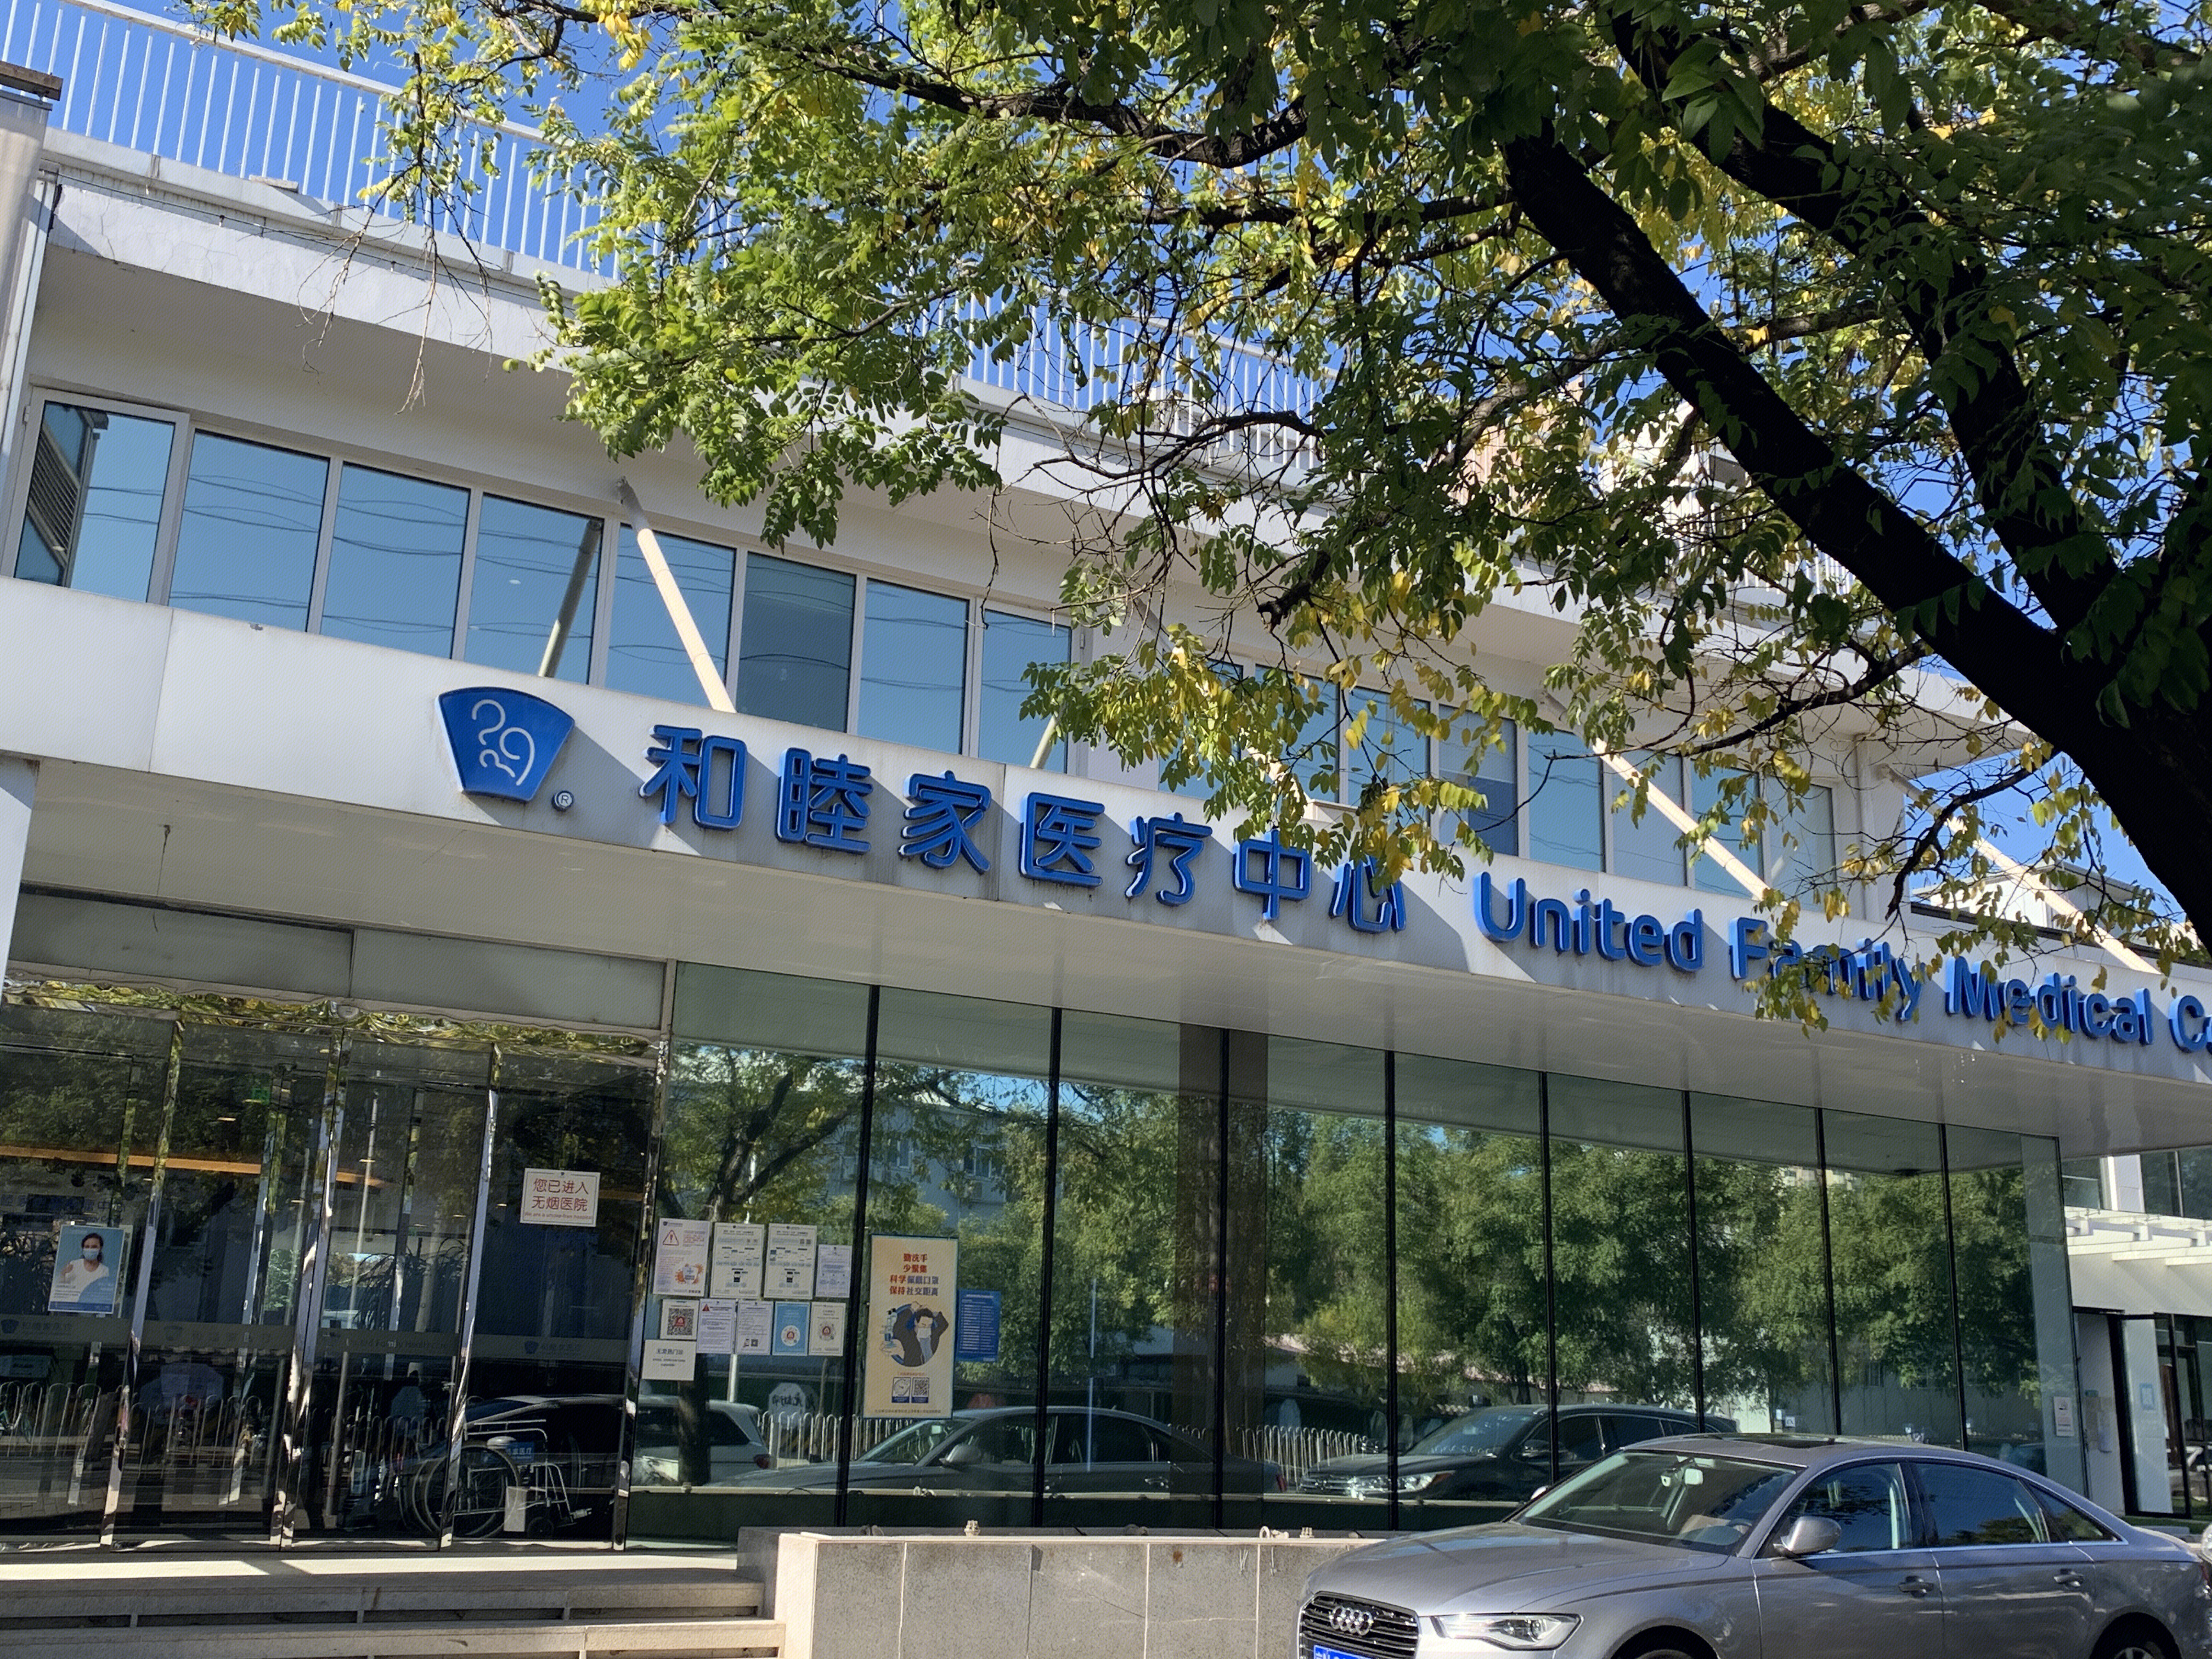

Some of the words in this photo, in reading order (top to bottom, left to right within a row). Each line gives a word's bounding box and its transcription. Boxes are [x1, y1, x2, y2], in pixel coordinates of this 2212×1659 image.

[639, 724, 1407, 933] 和睦家医疗中心
[1474, 872, 1704, 972] United
[1945, 957, 2154, 1046] Medical
[2168, 995, 2212, 1056] C
[532, 1196, 588, 1211] 无烟医院
[533, 1178, 589, 1194] 您已进入
